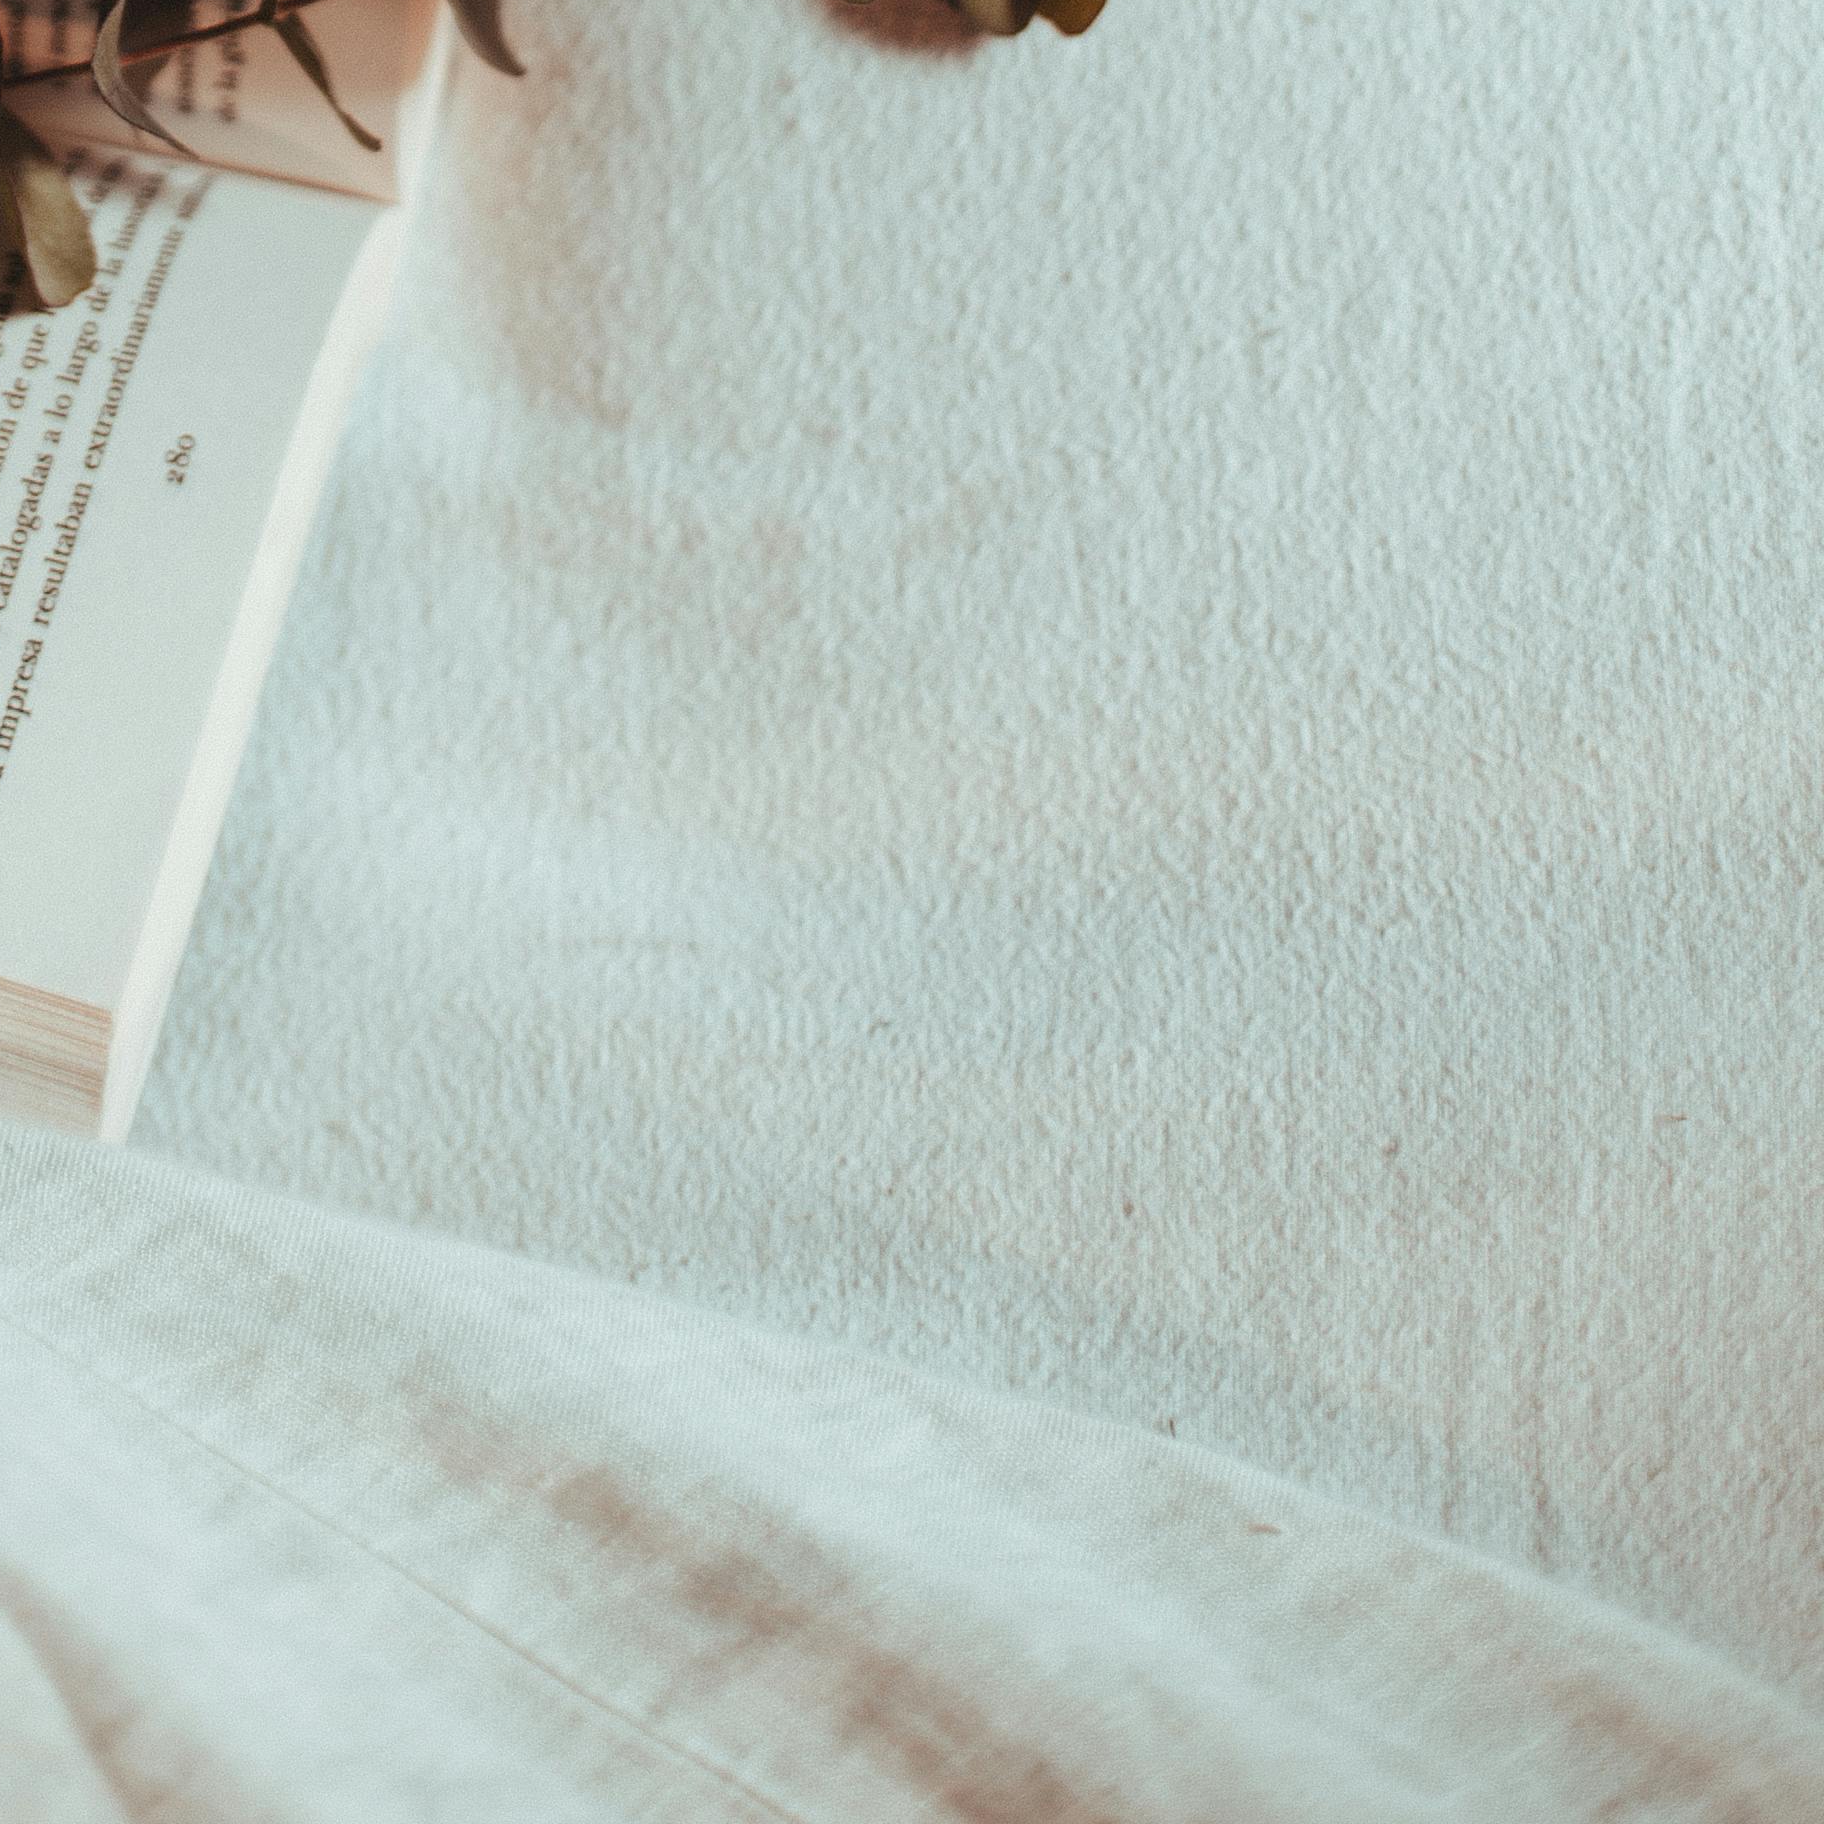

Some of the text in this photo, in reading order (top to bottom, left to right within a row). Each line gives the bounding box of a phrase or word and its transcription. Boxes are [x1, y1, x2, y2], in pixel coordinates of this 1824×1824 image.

[17, 318, 48, 374] que
[54, 317, 103, 388] largo
[31, 477, 94, 629] resultaban
[81, 225, 186, 473] extraordinariamente
[161, 430, 201, 490] 280
